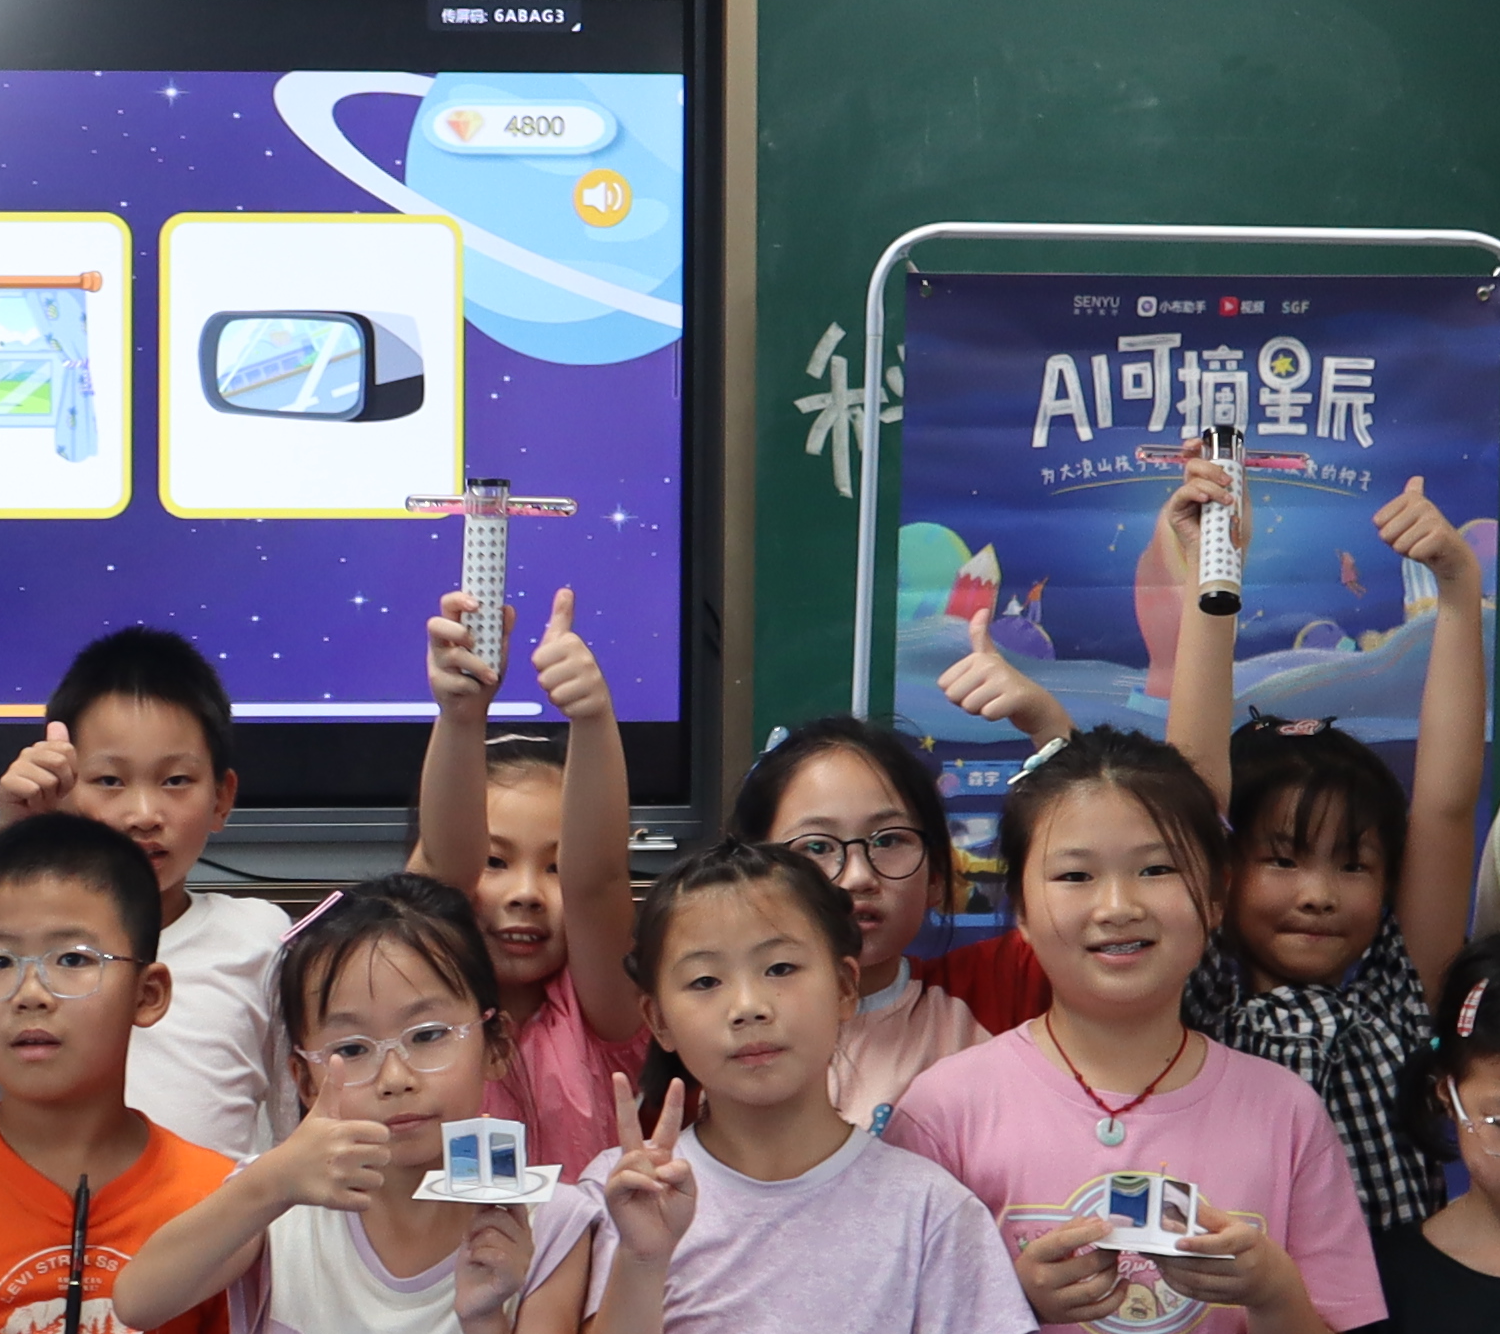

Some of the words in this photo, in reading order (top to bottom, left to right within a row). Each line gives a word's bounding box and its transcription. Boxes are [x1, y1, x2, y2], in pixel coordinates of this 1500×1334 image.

[493, 8, 565, 23] 6ABAG3
[504, 115, 566, 138] 4800
[1073, 295, 1120, 308] SENYU
[1281, 300, 1310, 314] SGF
